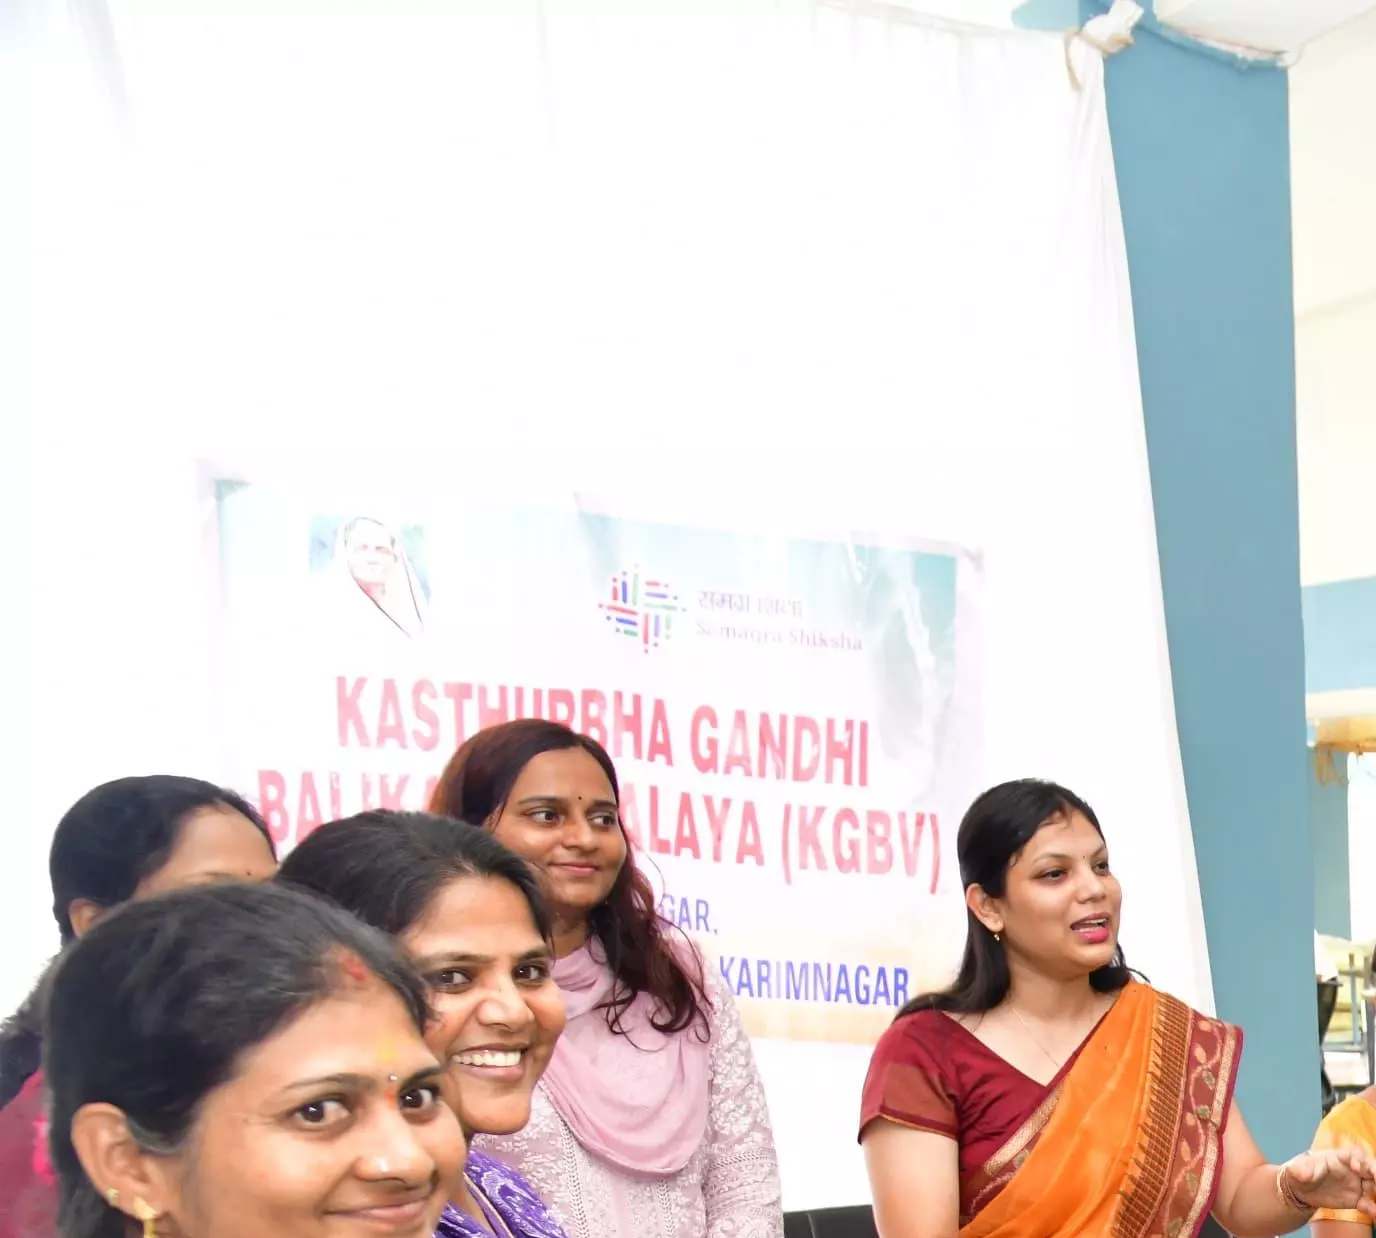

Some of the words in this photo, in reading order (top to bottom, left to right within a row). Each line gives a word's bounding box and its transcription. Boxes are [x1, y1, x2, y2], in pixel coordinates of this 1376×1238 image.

[790, 626, 862, 652] Shiksha
[689, 704, 868, 787] GANDHI
[781, 803, 941, 895] (KGBV)
